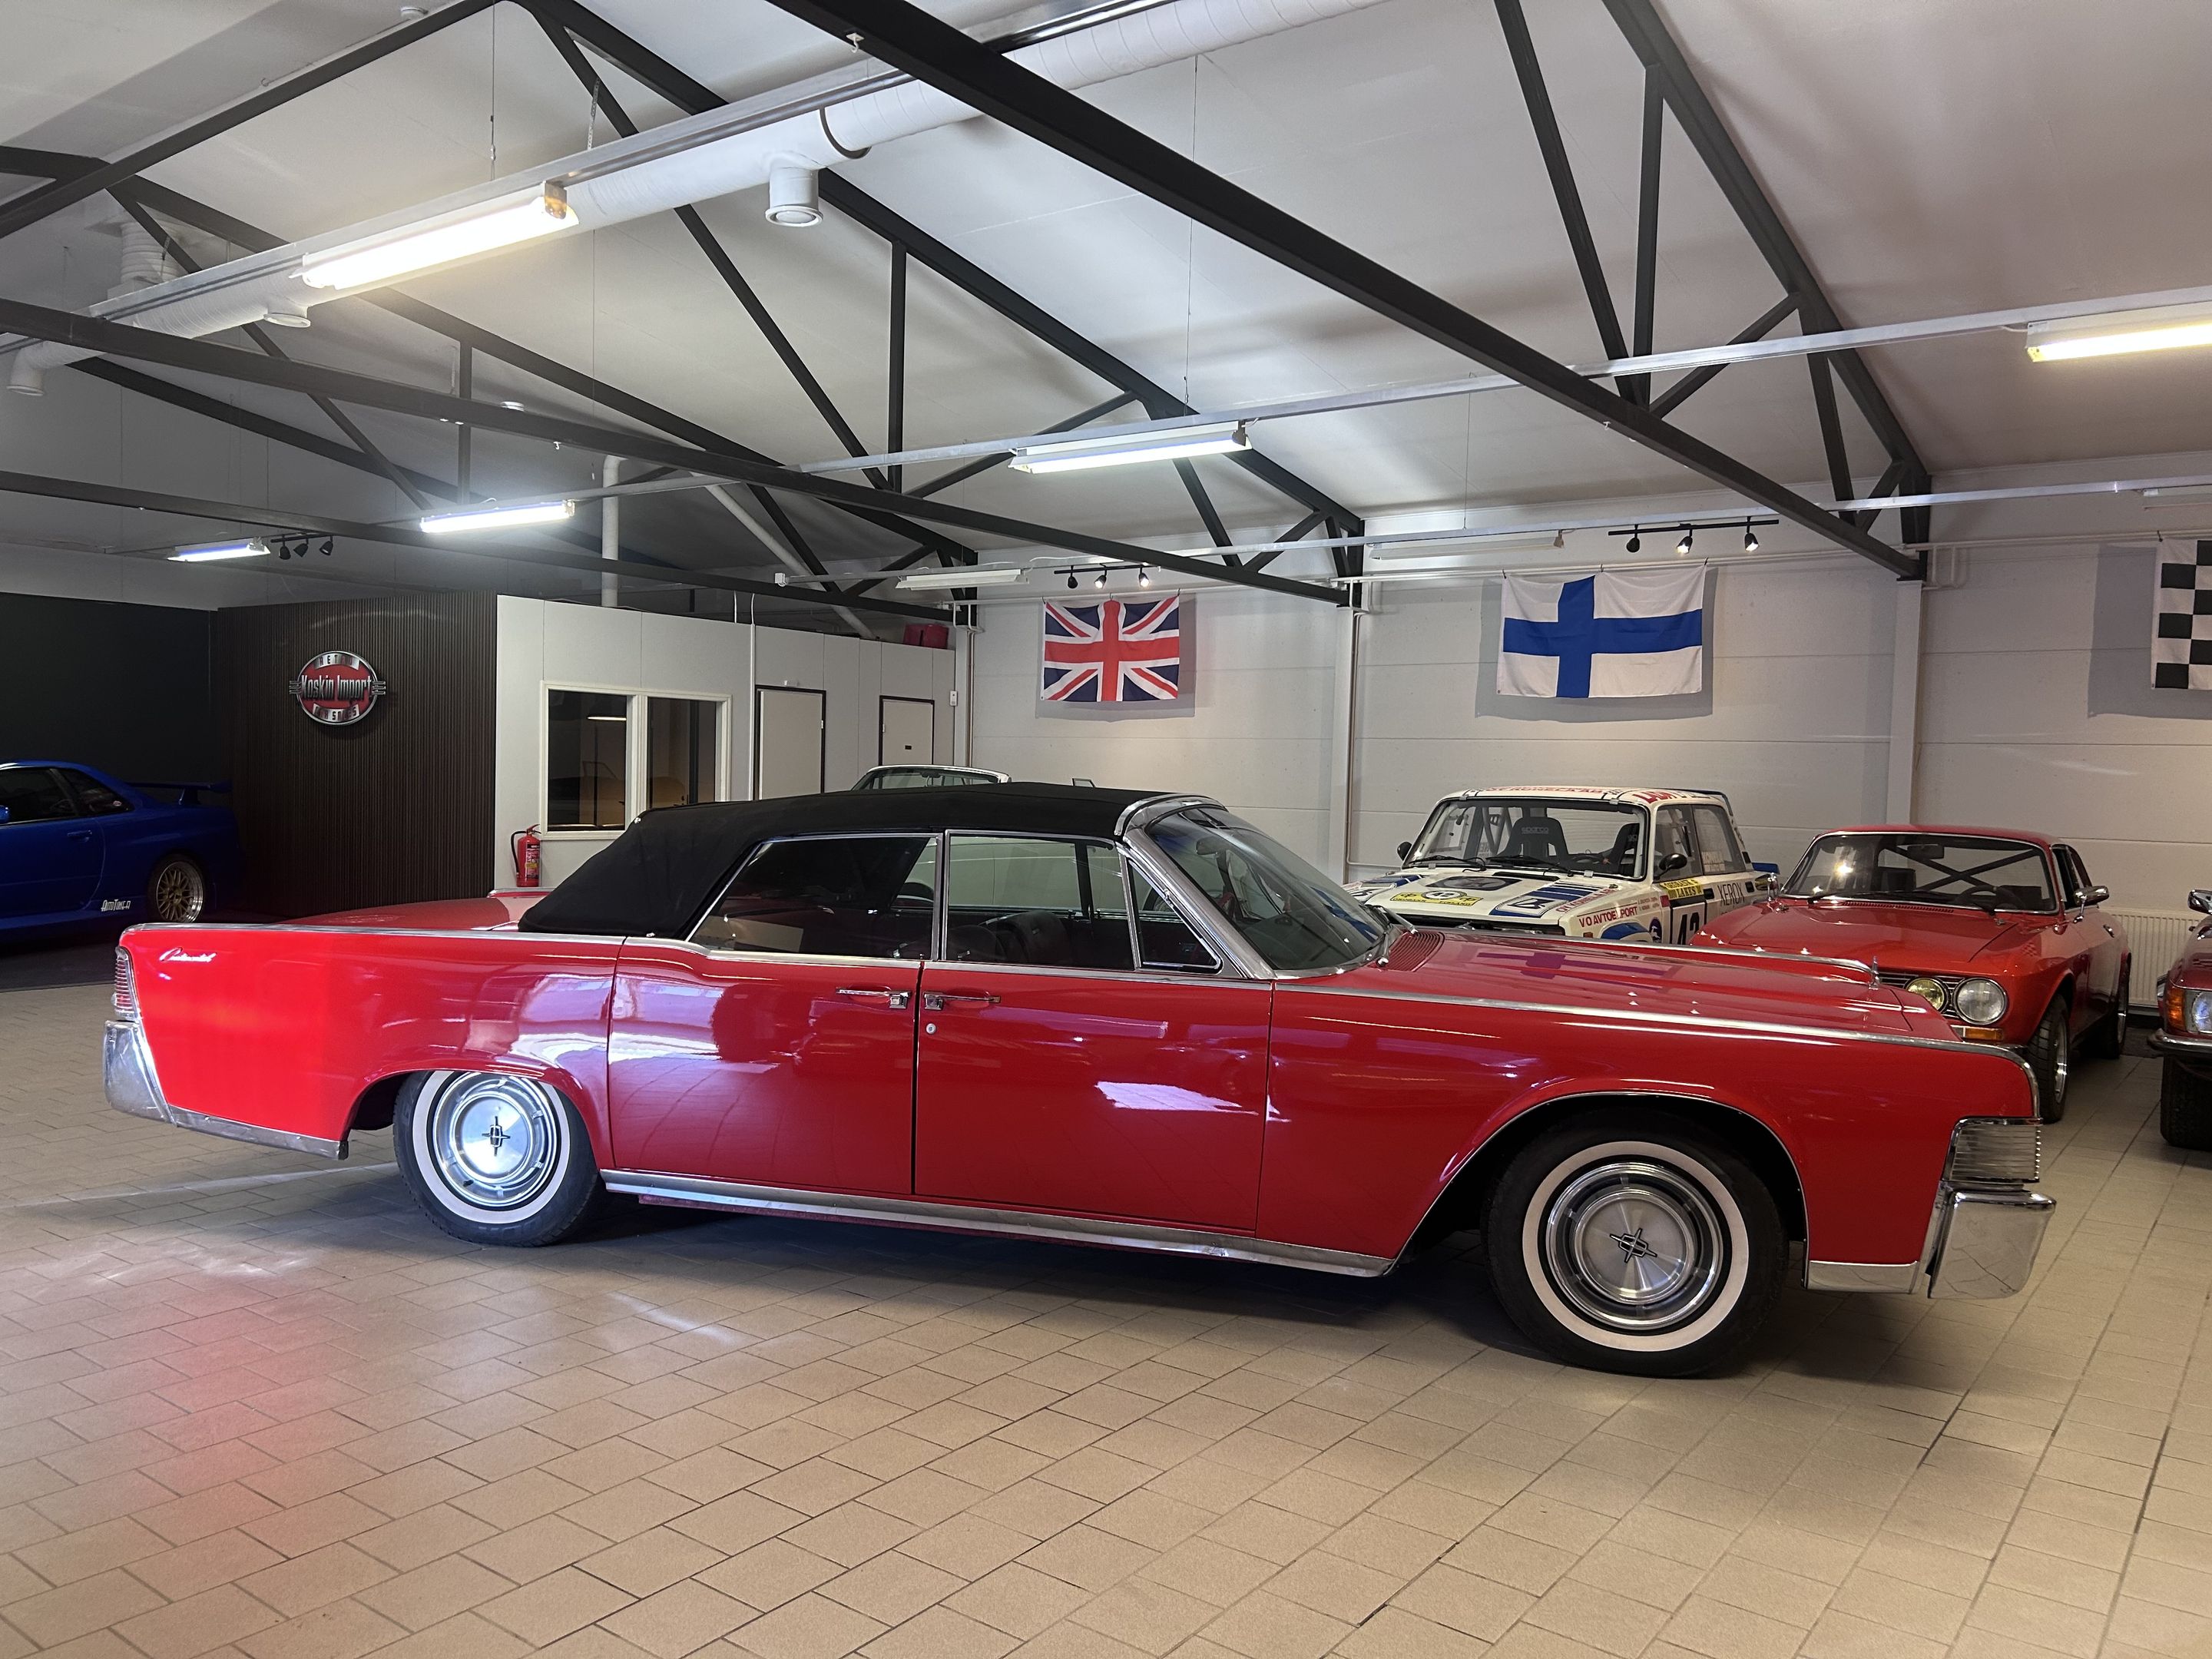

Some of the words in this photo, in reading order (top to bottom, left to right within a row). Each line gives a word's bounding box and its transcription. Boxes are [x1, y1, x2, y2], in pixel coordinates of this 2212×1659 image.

[301, 675, 334, 700] Koskin
[337, 675, 372, 700] Import
[1677, 886, 1697, 898] LAKES
[1717, 882, 1744, 906] XEROX
